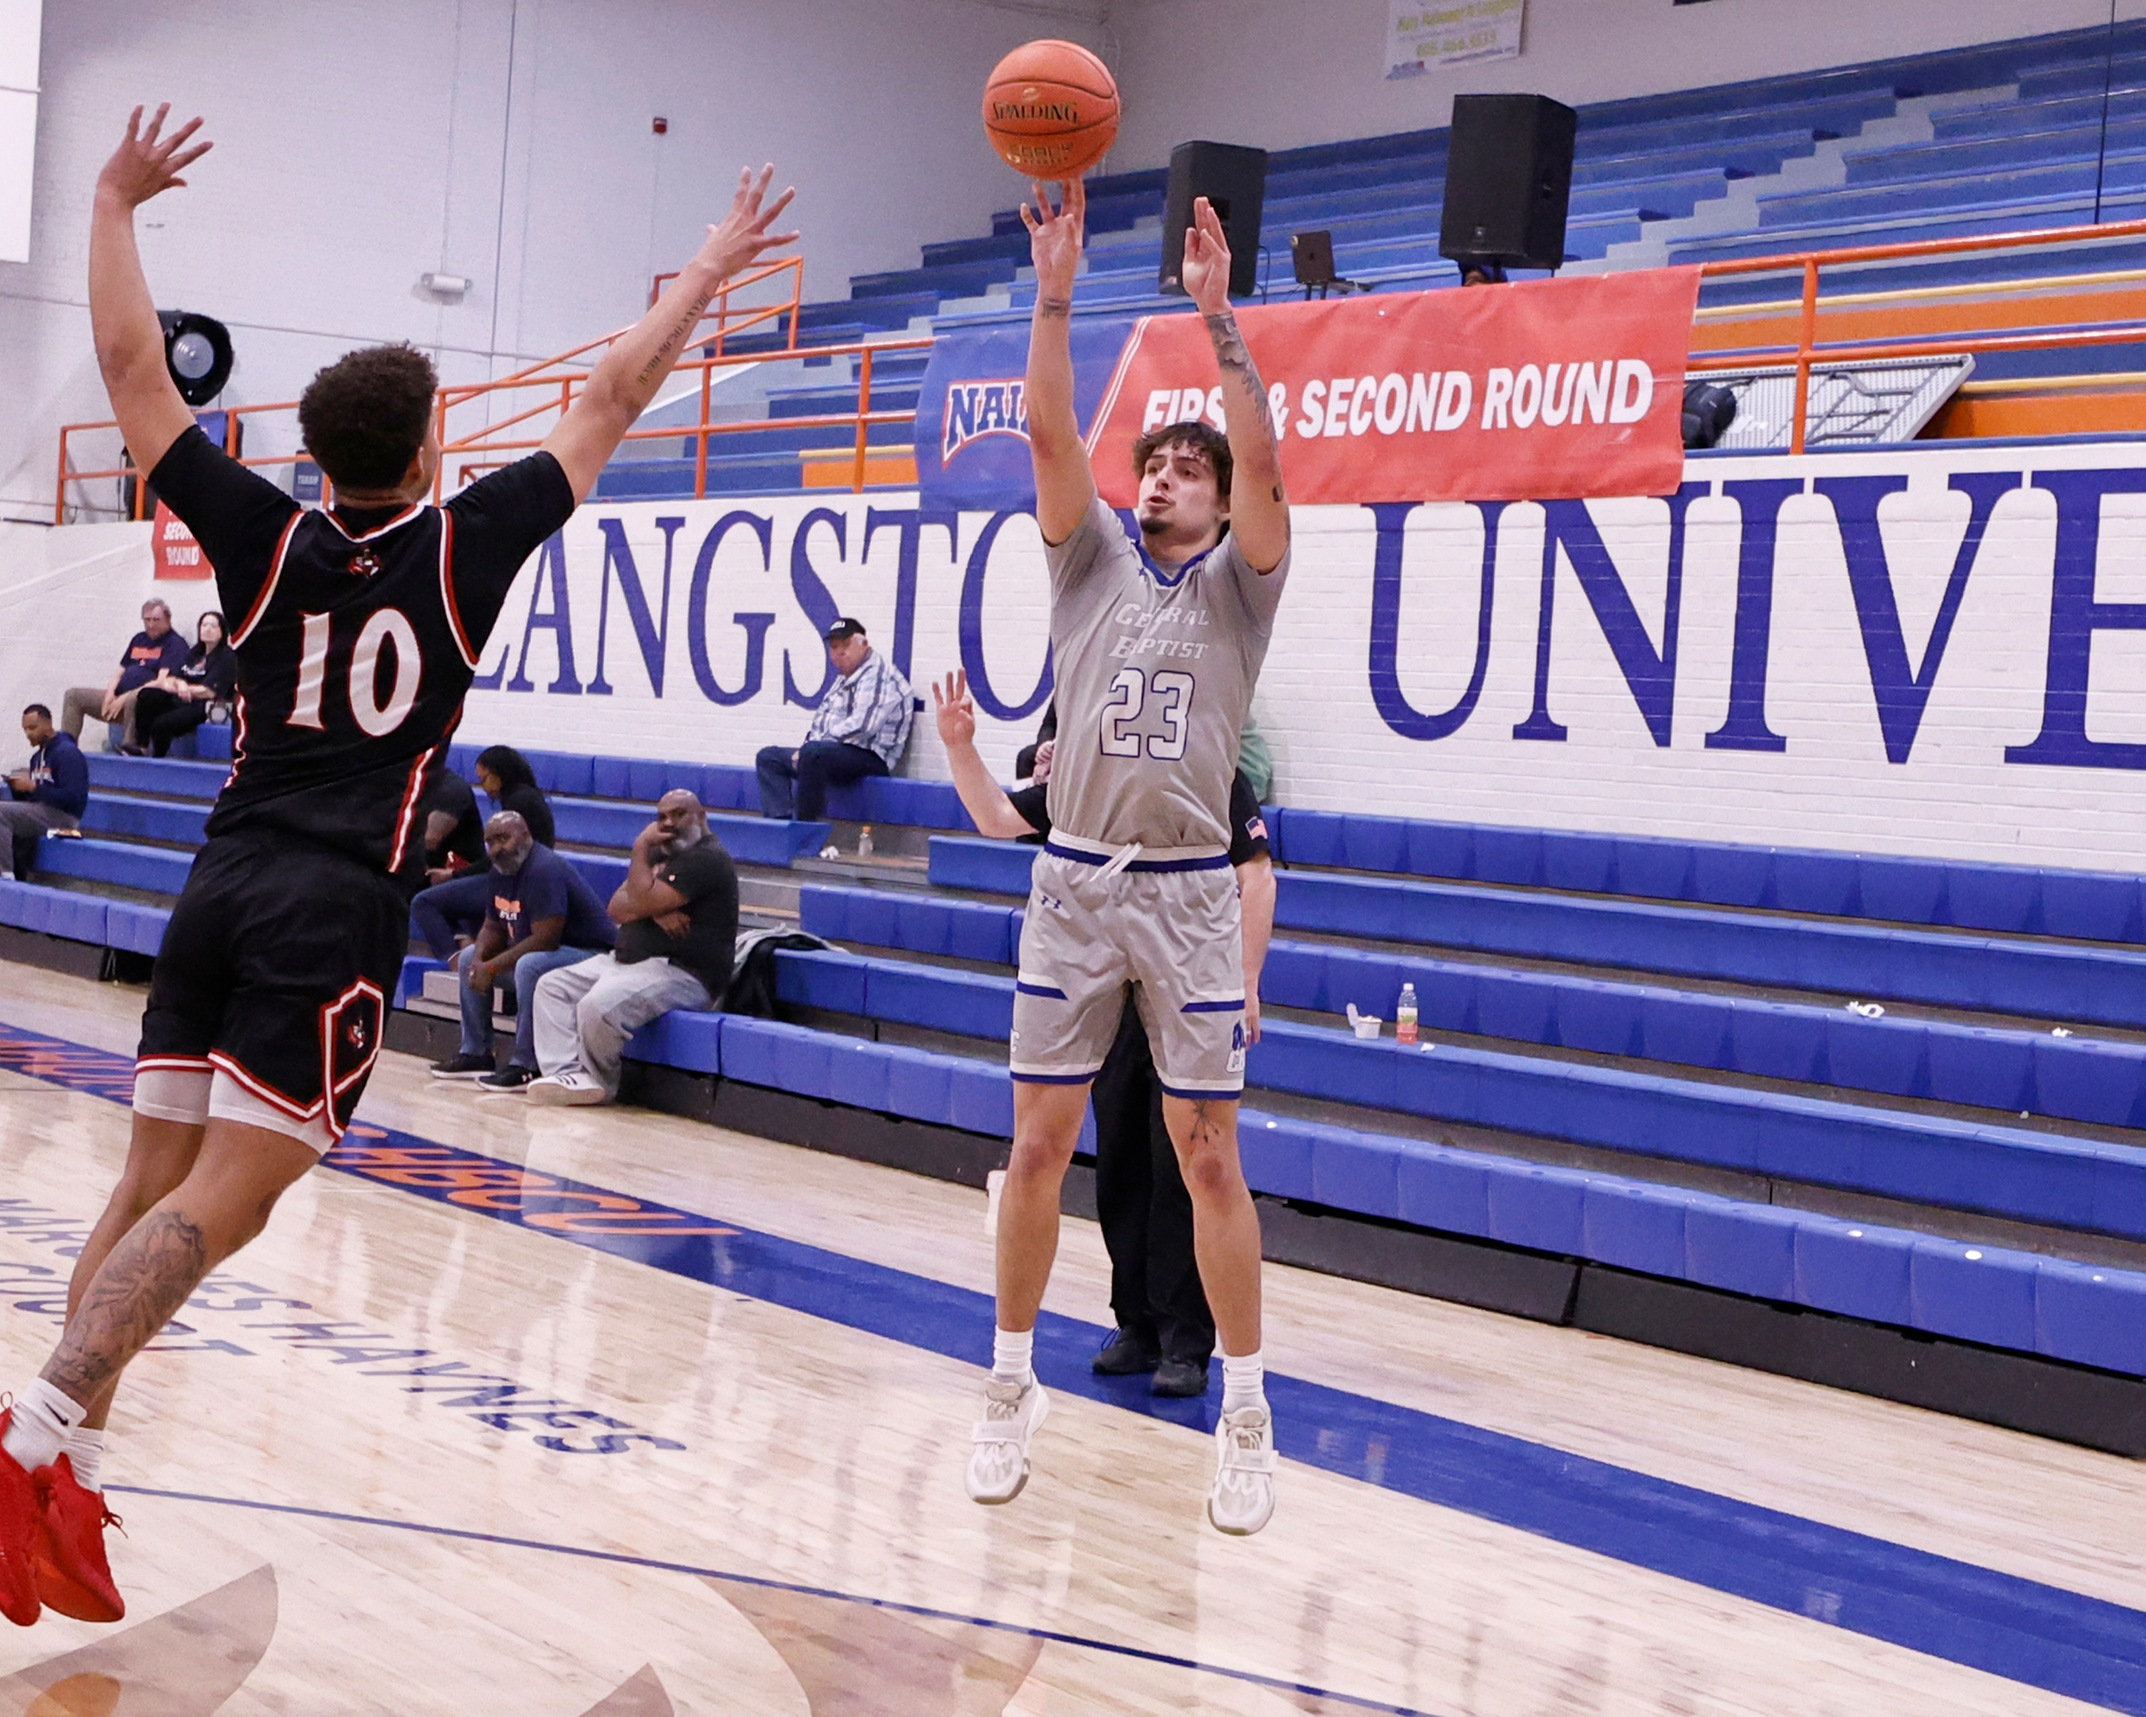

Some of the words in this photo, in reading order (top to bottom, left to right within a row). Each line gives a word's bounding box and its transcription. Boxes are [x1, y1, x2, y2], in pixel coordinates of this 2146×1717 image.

[993, 102, 1078, 124] SPALDING
[943, 379, 1031, 465] NAI
[1142, 384, 1227, 438] FIRS
[1268, 382, 1290, 441] &
[1295, 371, 1473, 439] SECOND
[1481, 359, 1655, 430] ROUND
[163, 521, 195, 541] SECO
[472, 503, 1141, 722] ANGSTO
[1114, 602, 1210, 631] CERAL
[286, 606, 425, 738] 10
[1100, 667, 1196, 761] 23
[239, 1321, 688, 1455] HAYNES
